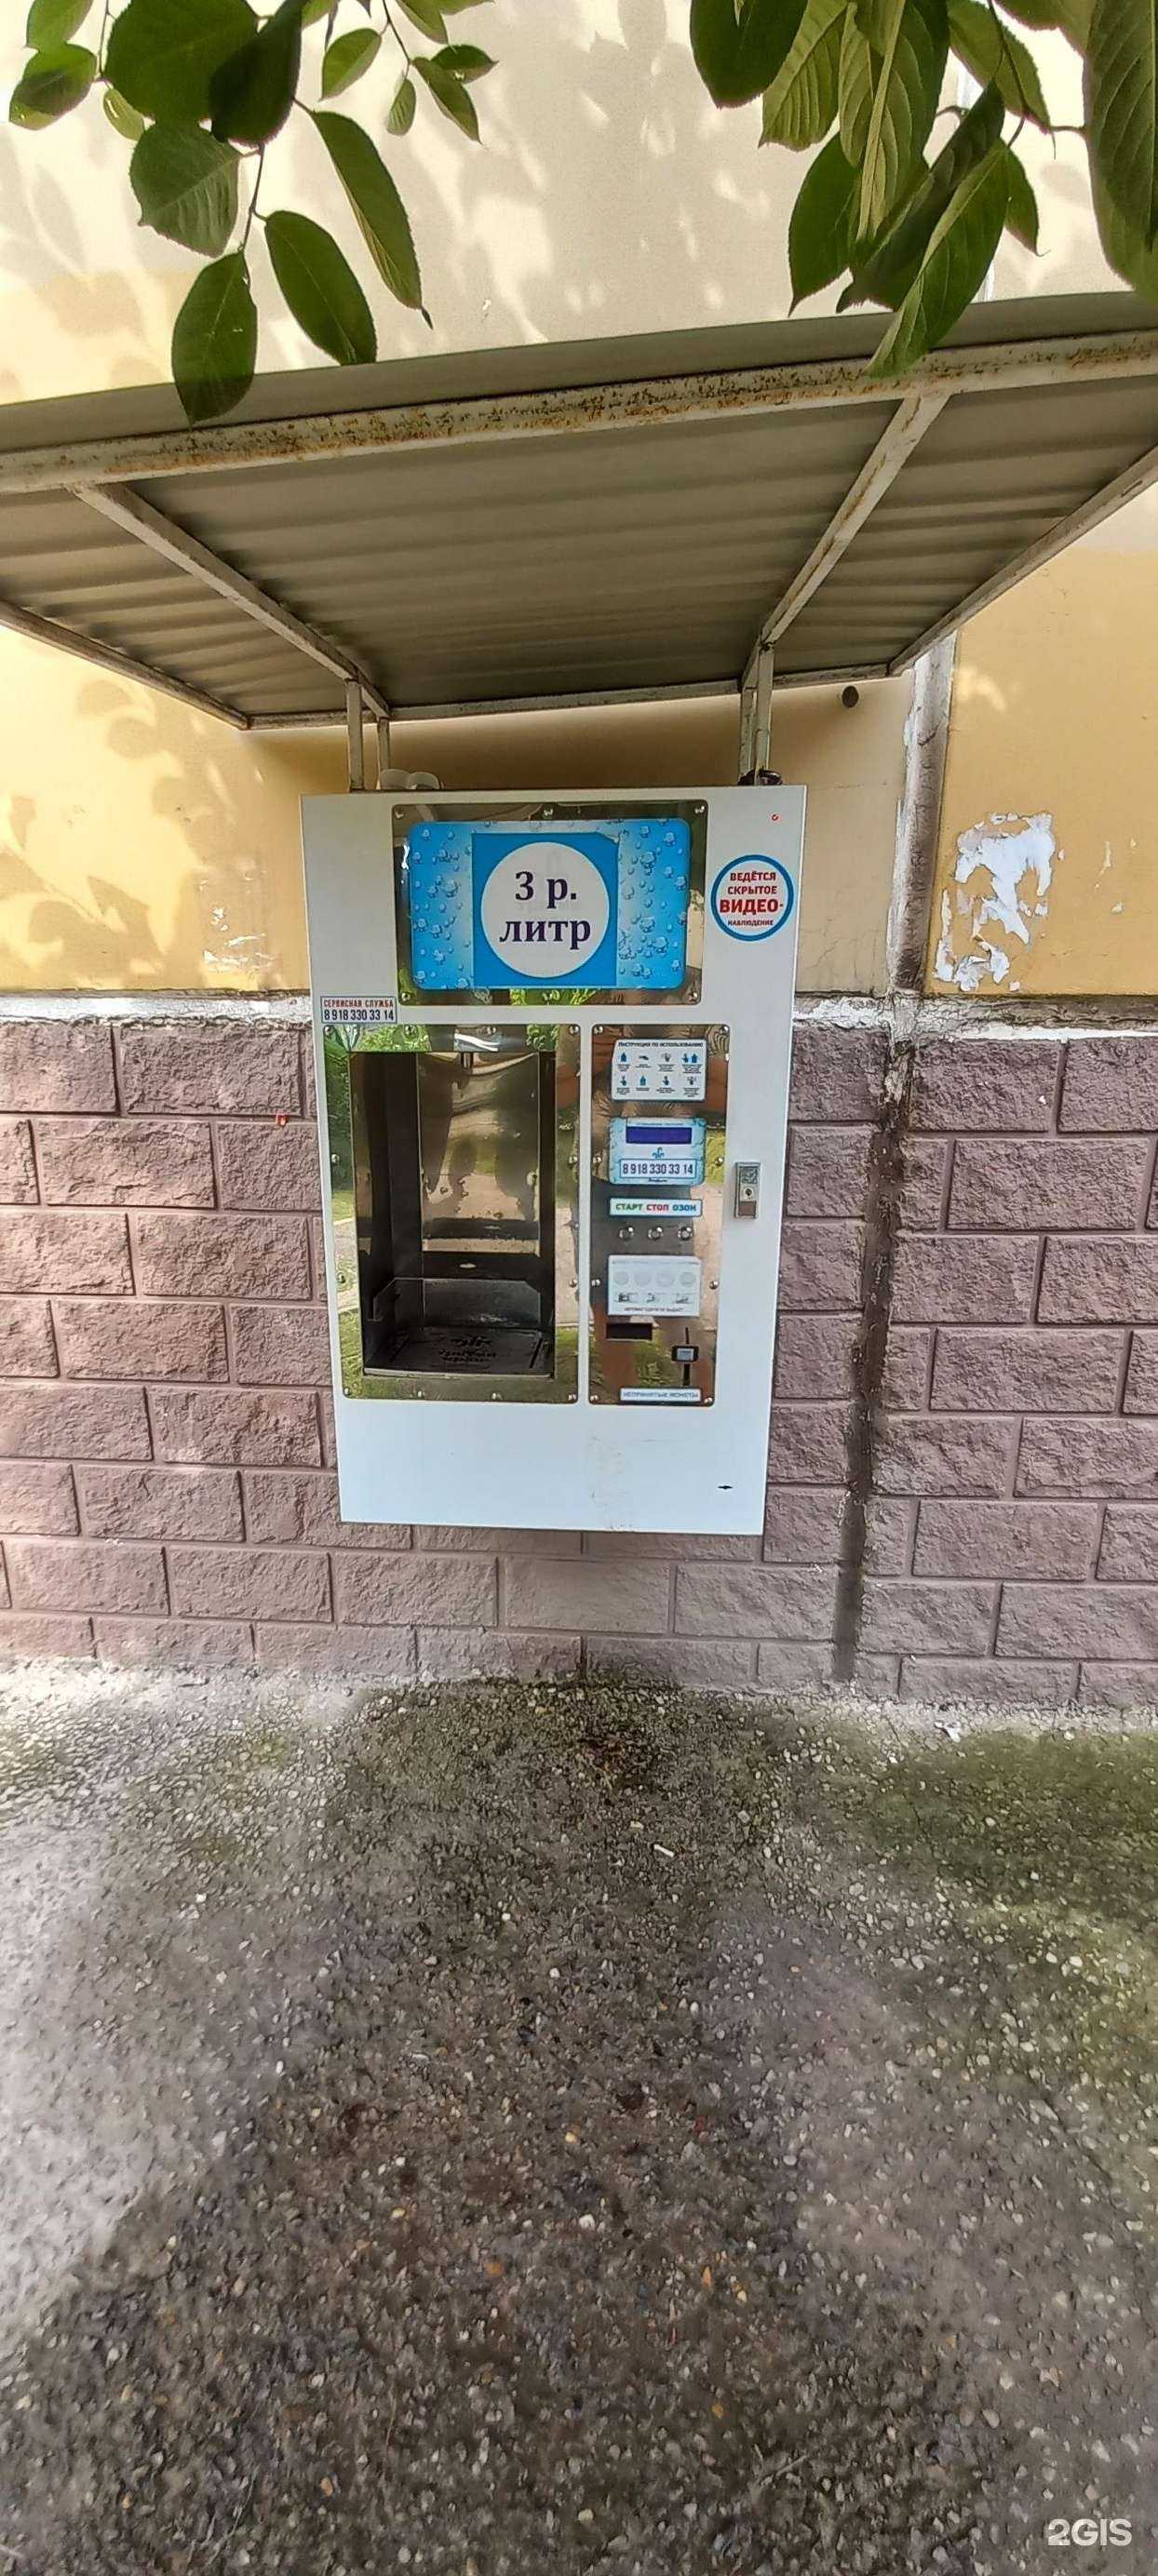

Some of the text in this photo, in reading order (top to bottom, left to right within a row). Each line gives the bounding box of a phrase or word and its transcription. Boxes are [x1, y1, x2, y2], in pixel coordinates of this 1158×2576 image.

[730, 871, 776, 882] ВЕДЁТСЯ
[515, 870, 577, 909] 3 р.
[727, 885, 777, 895] СКРЫТОЕ
[719, 898, 784, 916] ВИДЕО-
[499, 919, 591, 950] литр
[323, 999, 394, 1008] СЕРВИСНАЯ СЛУЖБА
[324, 1009, 394, 1021] 8 918 330 33 14
[623, 1163, 693, 1174] 8 918 330 33 14
